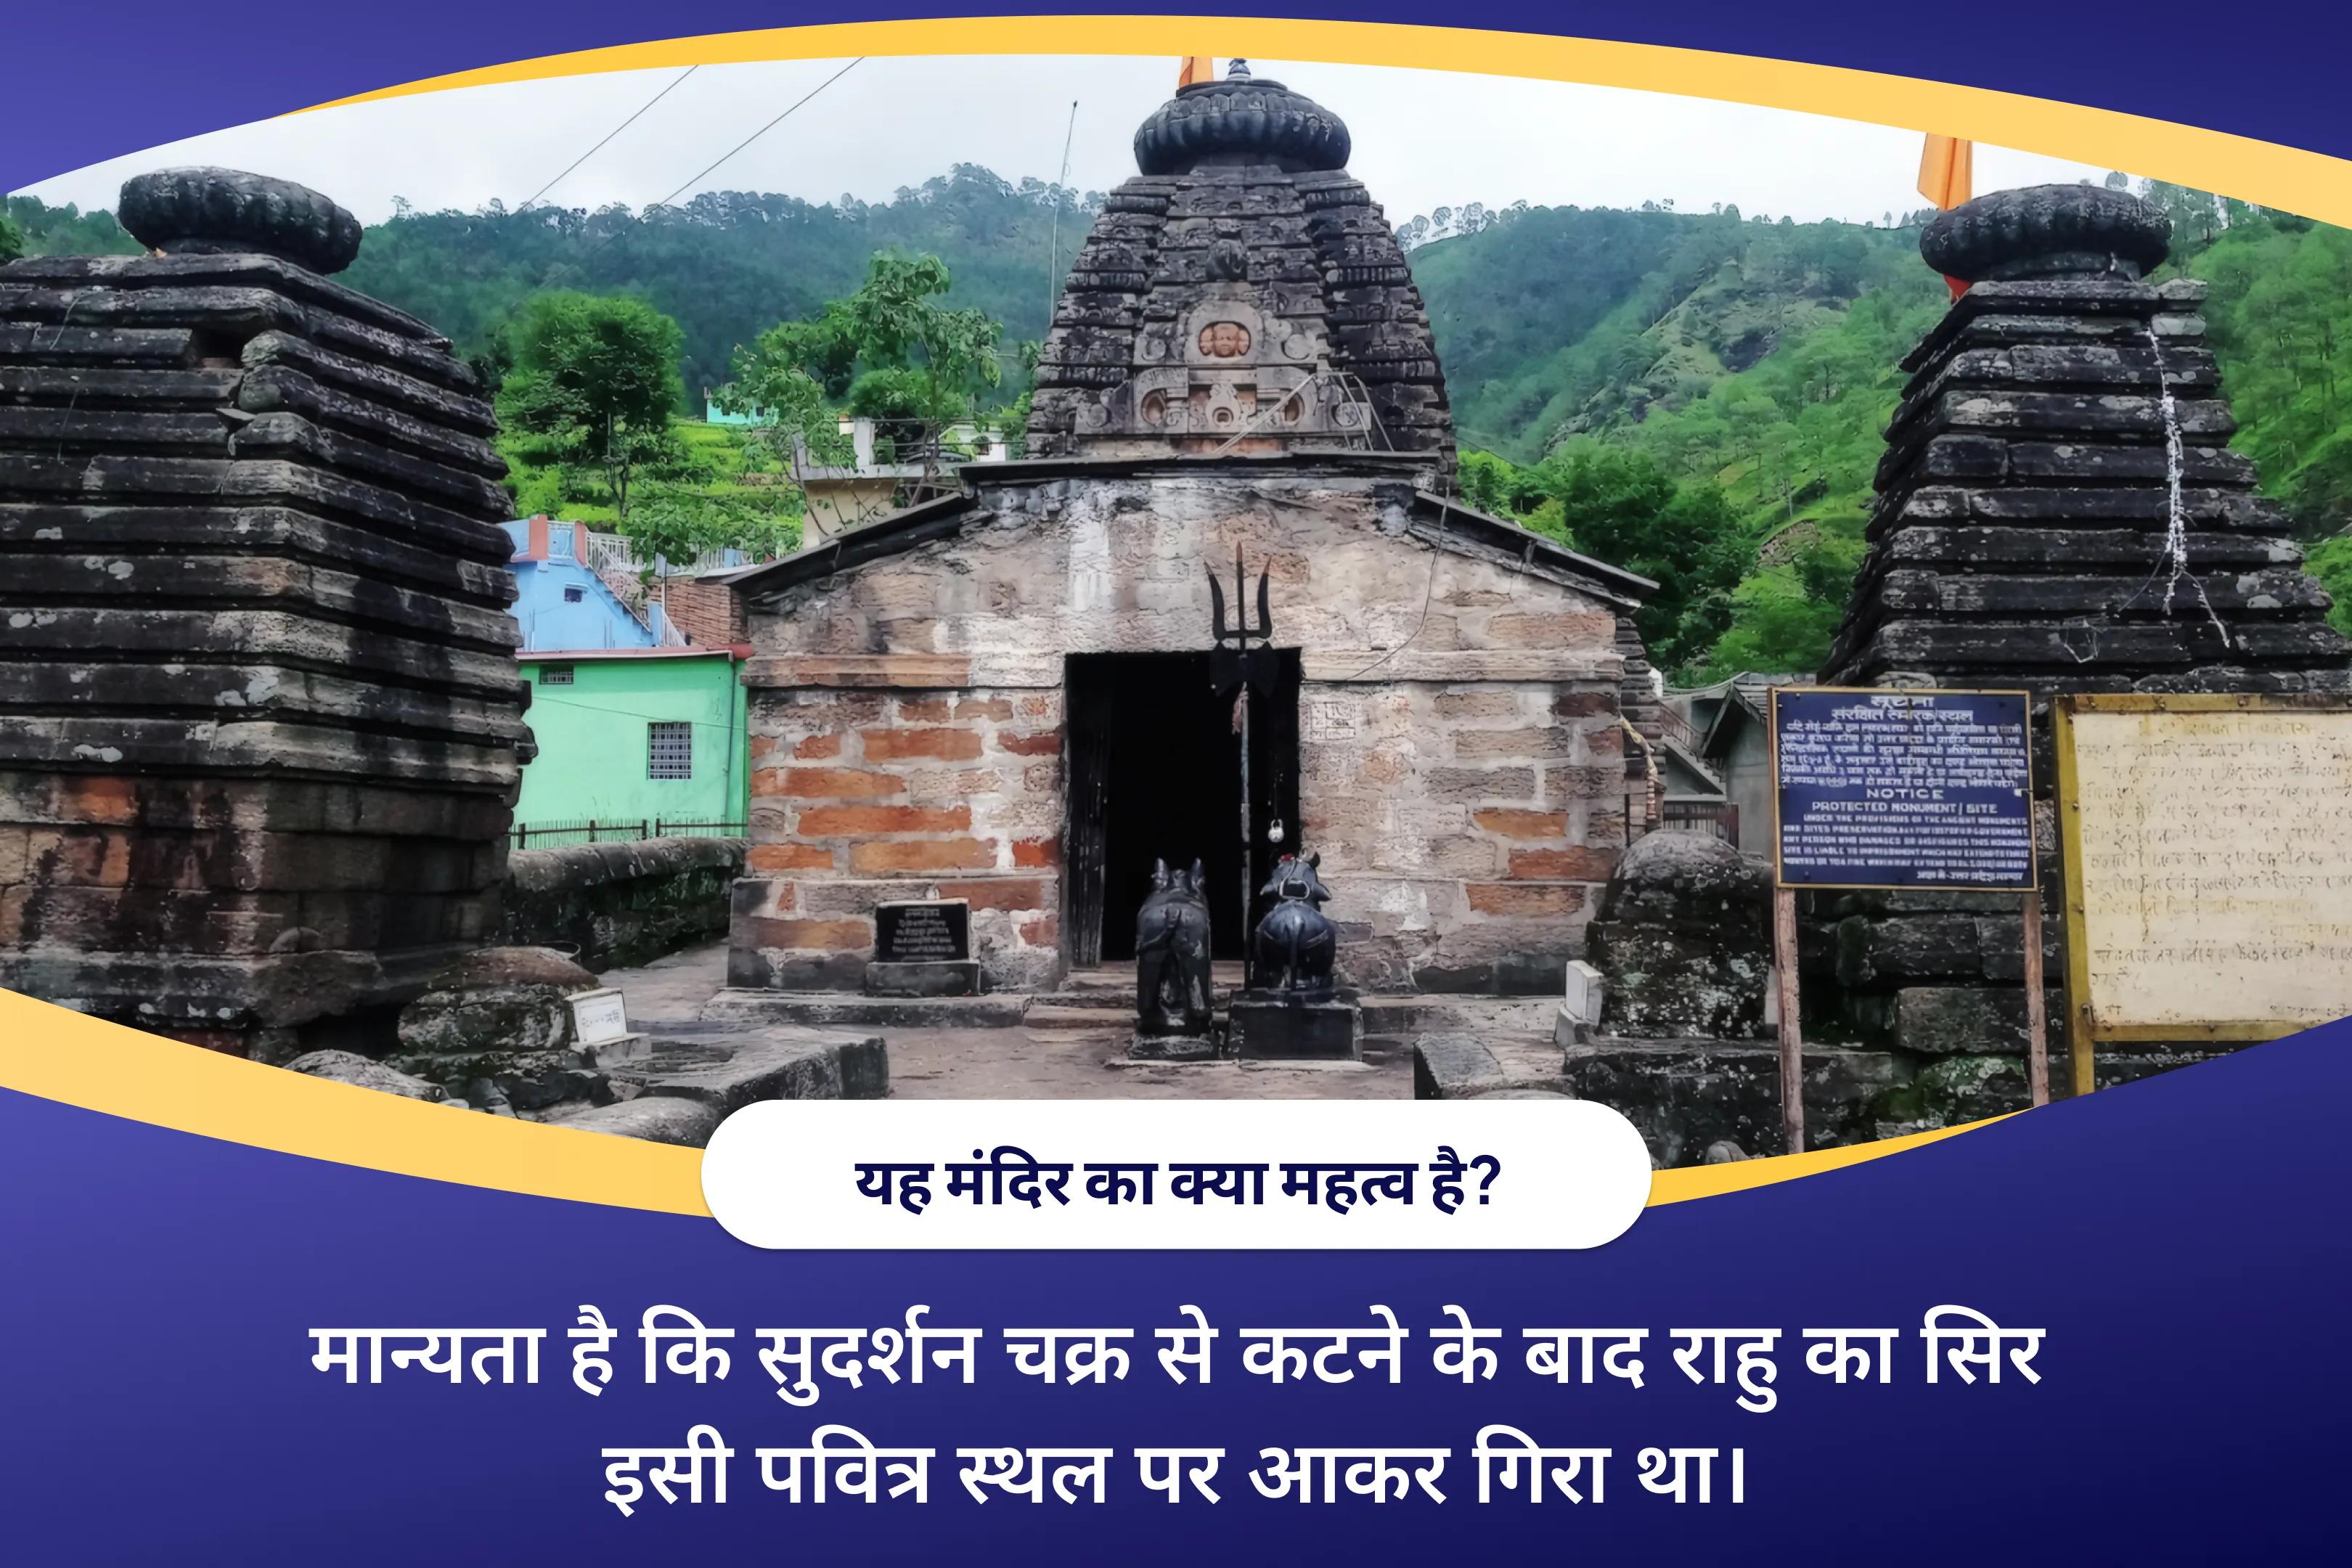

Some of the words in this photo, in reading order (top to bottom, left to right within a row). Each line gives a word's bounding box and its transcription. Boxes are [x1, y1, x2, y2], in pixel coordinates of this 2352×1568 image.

[1832, 705, 1885, 720] संरक्षित
[1866, 788, 1944, 799] NOTICE
[1812, 801, 1887, 812] PROTECTED
[1891, 803, 1956, 813] MONUMENT
[1966, 804, 1998, 813] SITE
